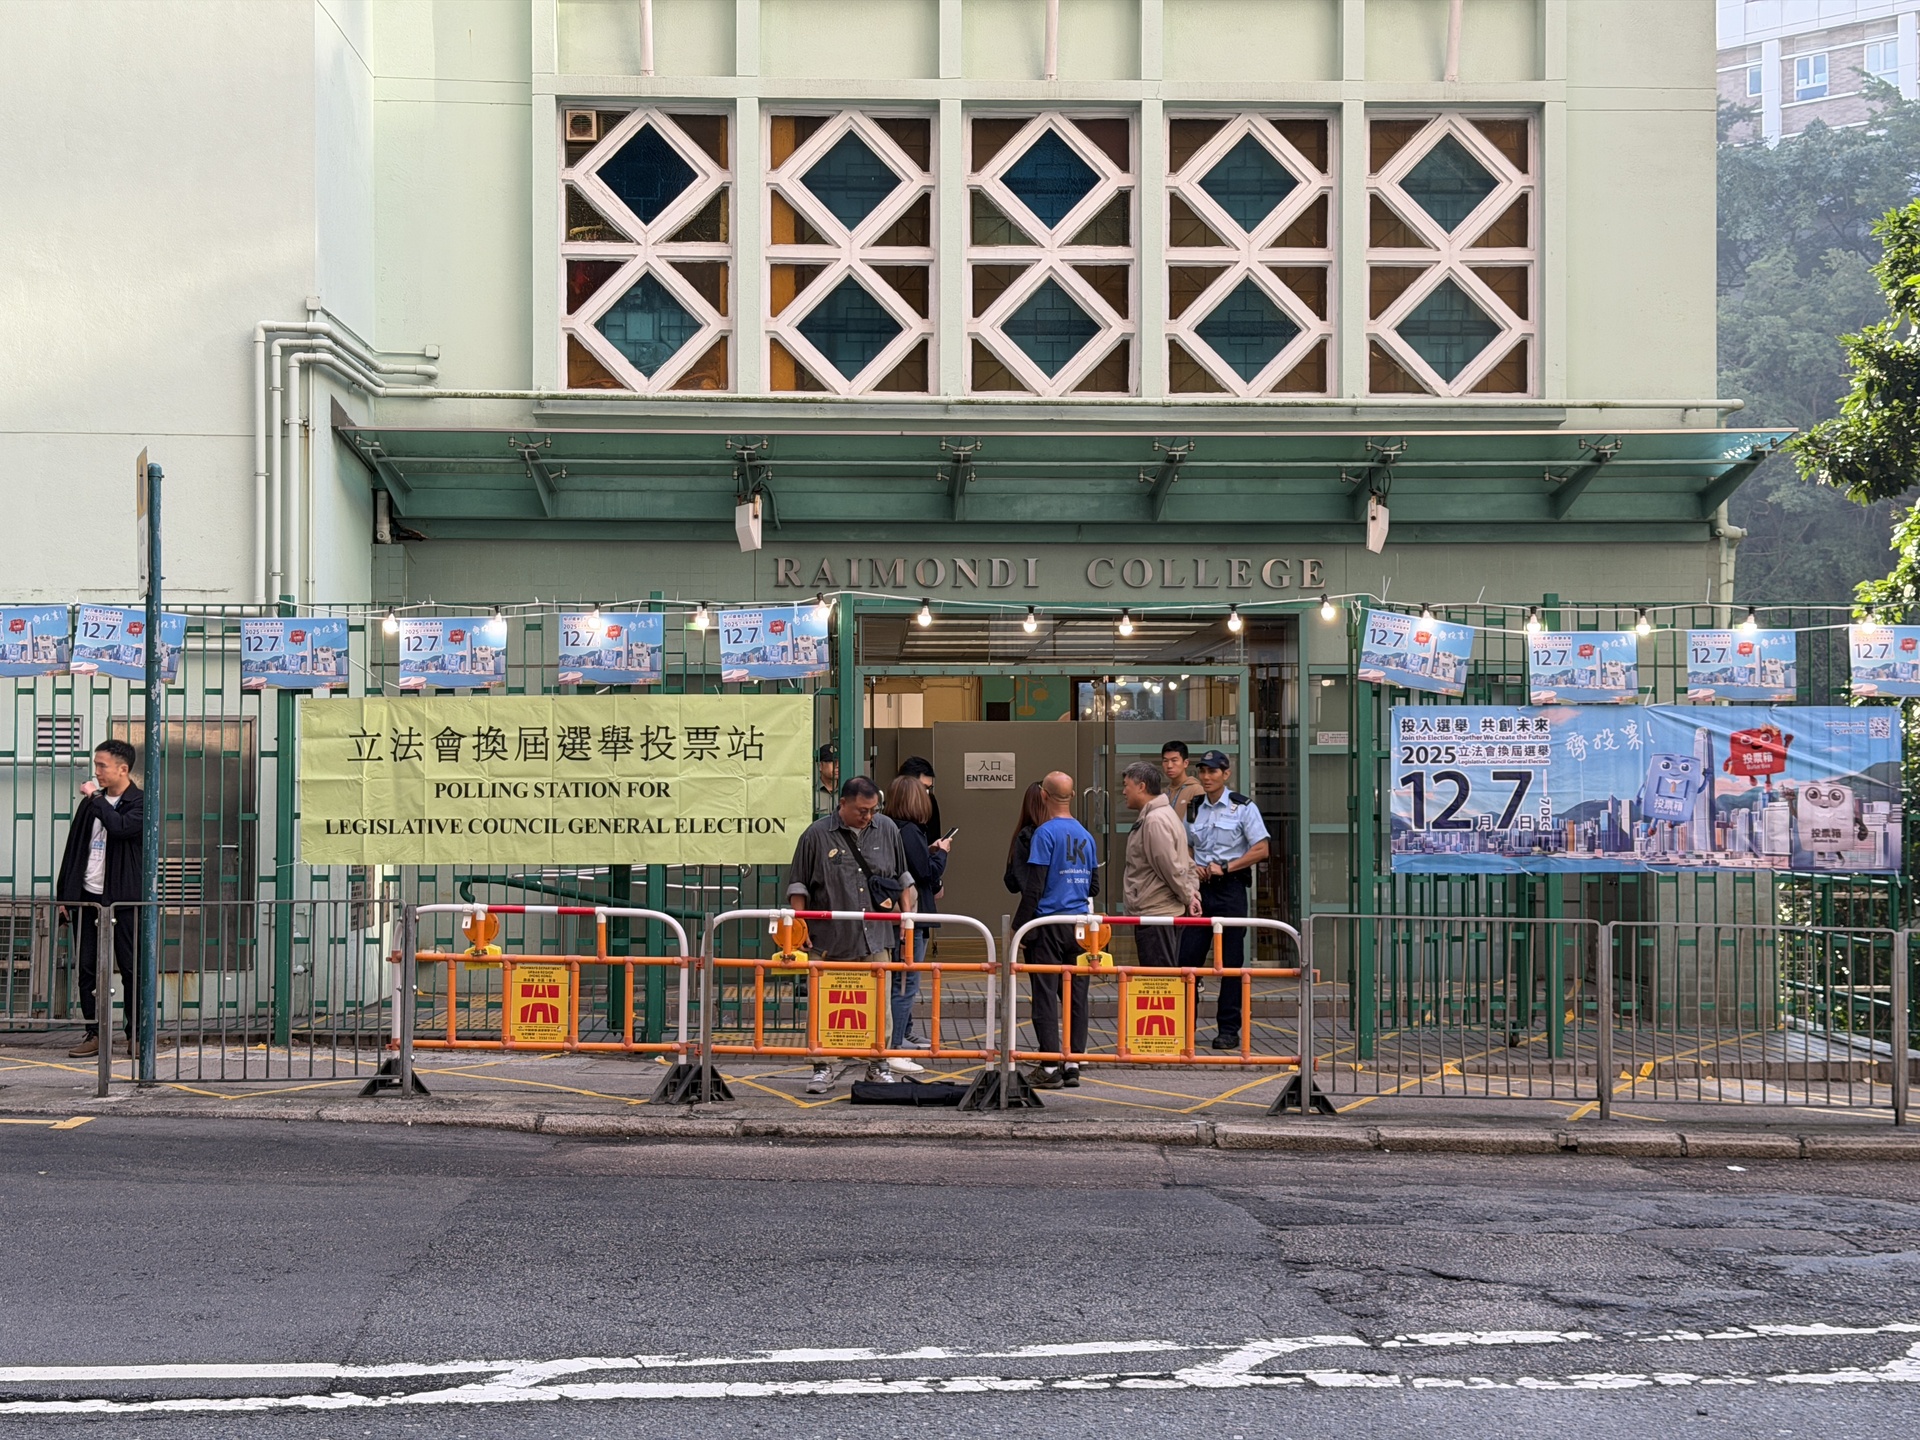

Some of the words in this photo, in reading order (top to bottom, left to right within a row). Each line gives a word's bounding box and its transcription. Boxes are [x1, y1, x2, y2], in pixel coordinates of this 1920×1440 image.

[773, 556, 1040, 589] RAIMONDI
[1086, 556, 1328, 589] COLLEGE
[1401, 718, 1468, 733] 投入選舉
[1481, 718, 1549, 733] 共創未來
[346, 724, 766, 764] 立法會換屆選舉投票站
[1454, 734, 1482, 742] Together
[1402, 746, 1456, 764] 2025
[1459, 745, 1549, 757] 立法會換屆選舉
[978, 760, 1001, 771] 入口
[966, 774, 1013, 782] ENTRANCE
[434, 782, 529, 799] POLLING
[533, 781, 621, 798] STATION
[626, 780, 672, 798] FOR
[1400, 770, 1532, 830] 12月7日
[325, 819, 463, 836] LEGISLATIVE
[467, 818, 565, 835] COUNCIL
[567, 818, 670, 835] GENERAL
[674, 817, 787, 835] ELECTION
[1541, 808, 1550, 830] DEC
